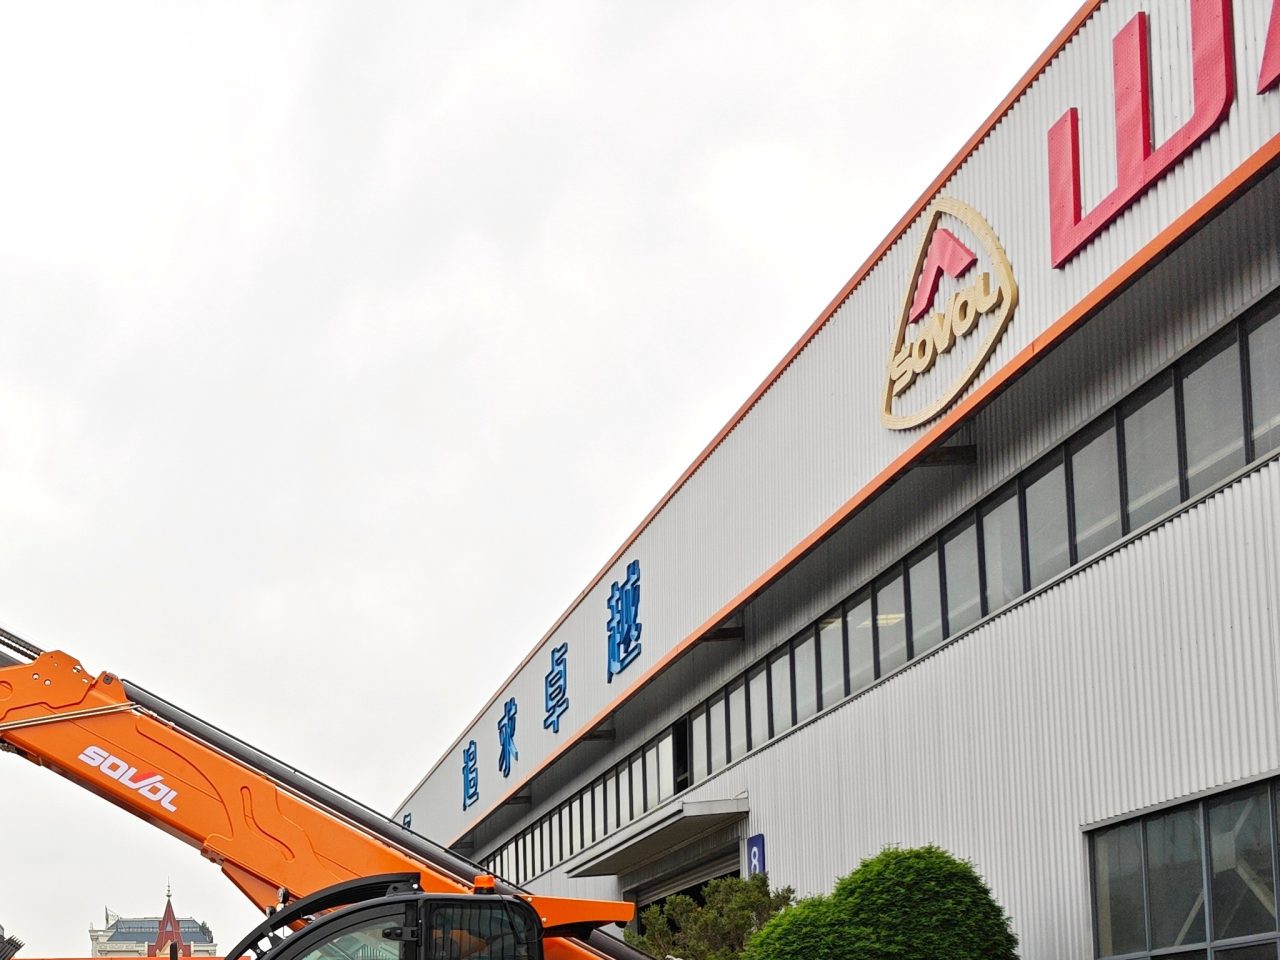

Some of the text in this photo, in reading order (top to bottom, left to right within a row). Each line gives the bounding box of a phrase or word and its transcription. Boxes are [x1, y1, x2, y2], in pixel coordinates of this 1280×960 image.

[1047, 0, 1280, 269] 山
[890, 272, 1004, 397] SOVOL
[462, 559, 642, 812] 追求卓越
[77, 745, 178, 813] SOVOL
[751, 846, 759, 874] 8
